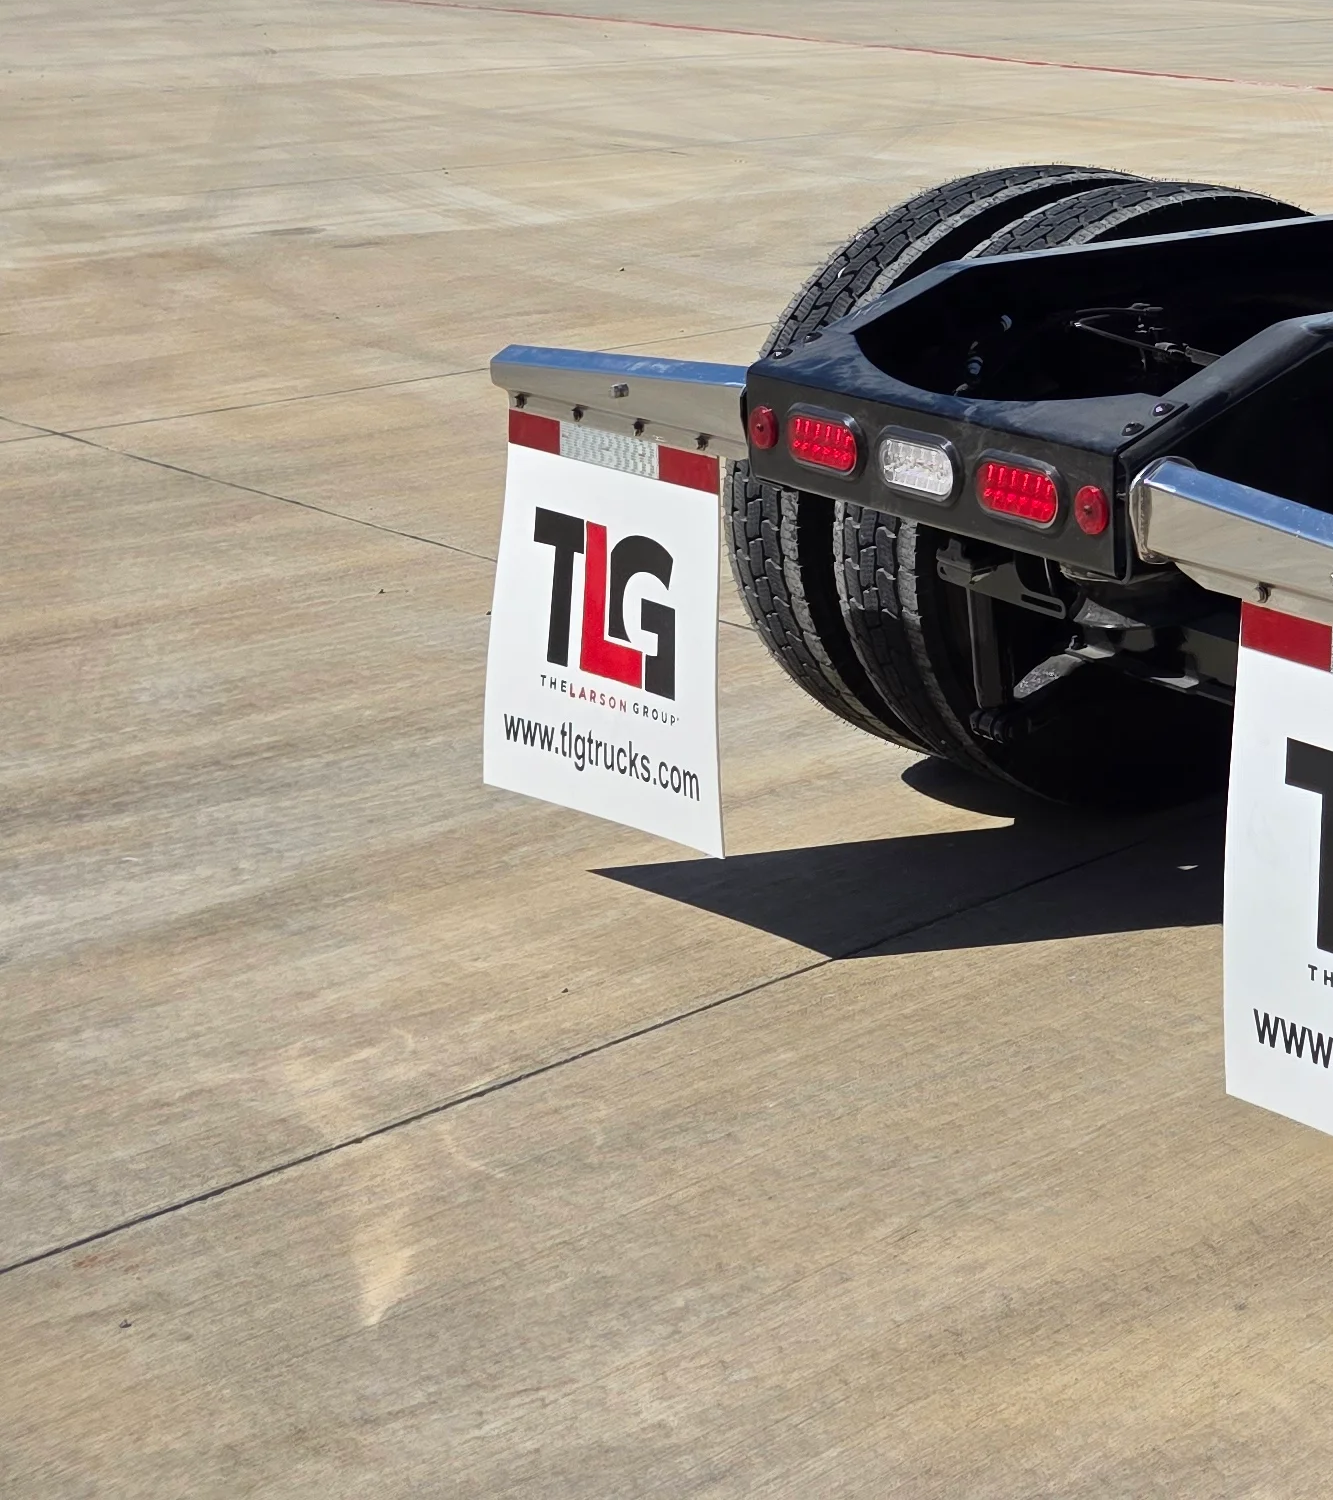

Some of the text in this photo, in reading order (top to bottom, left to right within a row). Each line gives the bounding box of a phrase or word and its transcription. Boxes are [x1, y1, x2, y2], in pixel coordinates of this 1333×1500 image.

[534, 506, 676, 701] TLG
[503, 713, 700, 802] www.tlgtrucks.com
[633, 703, 677, 726] GROUP
